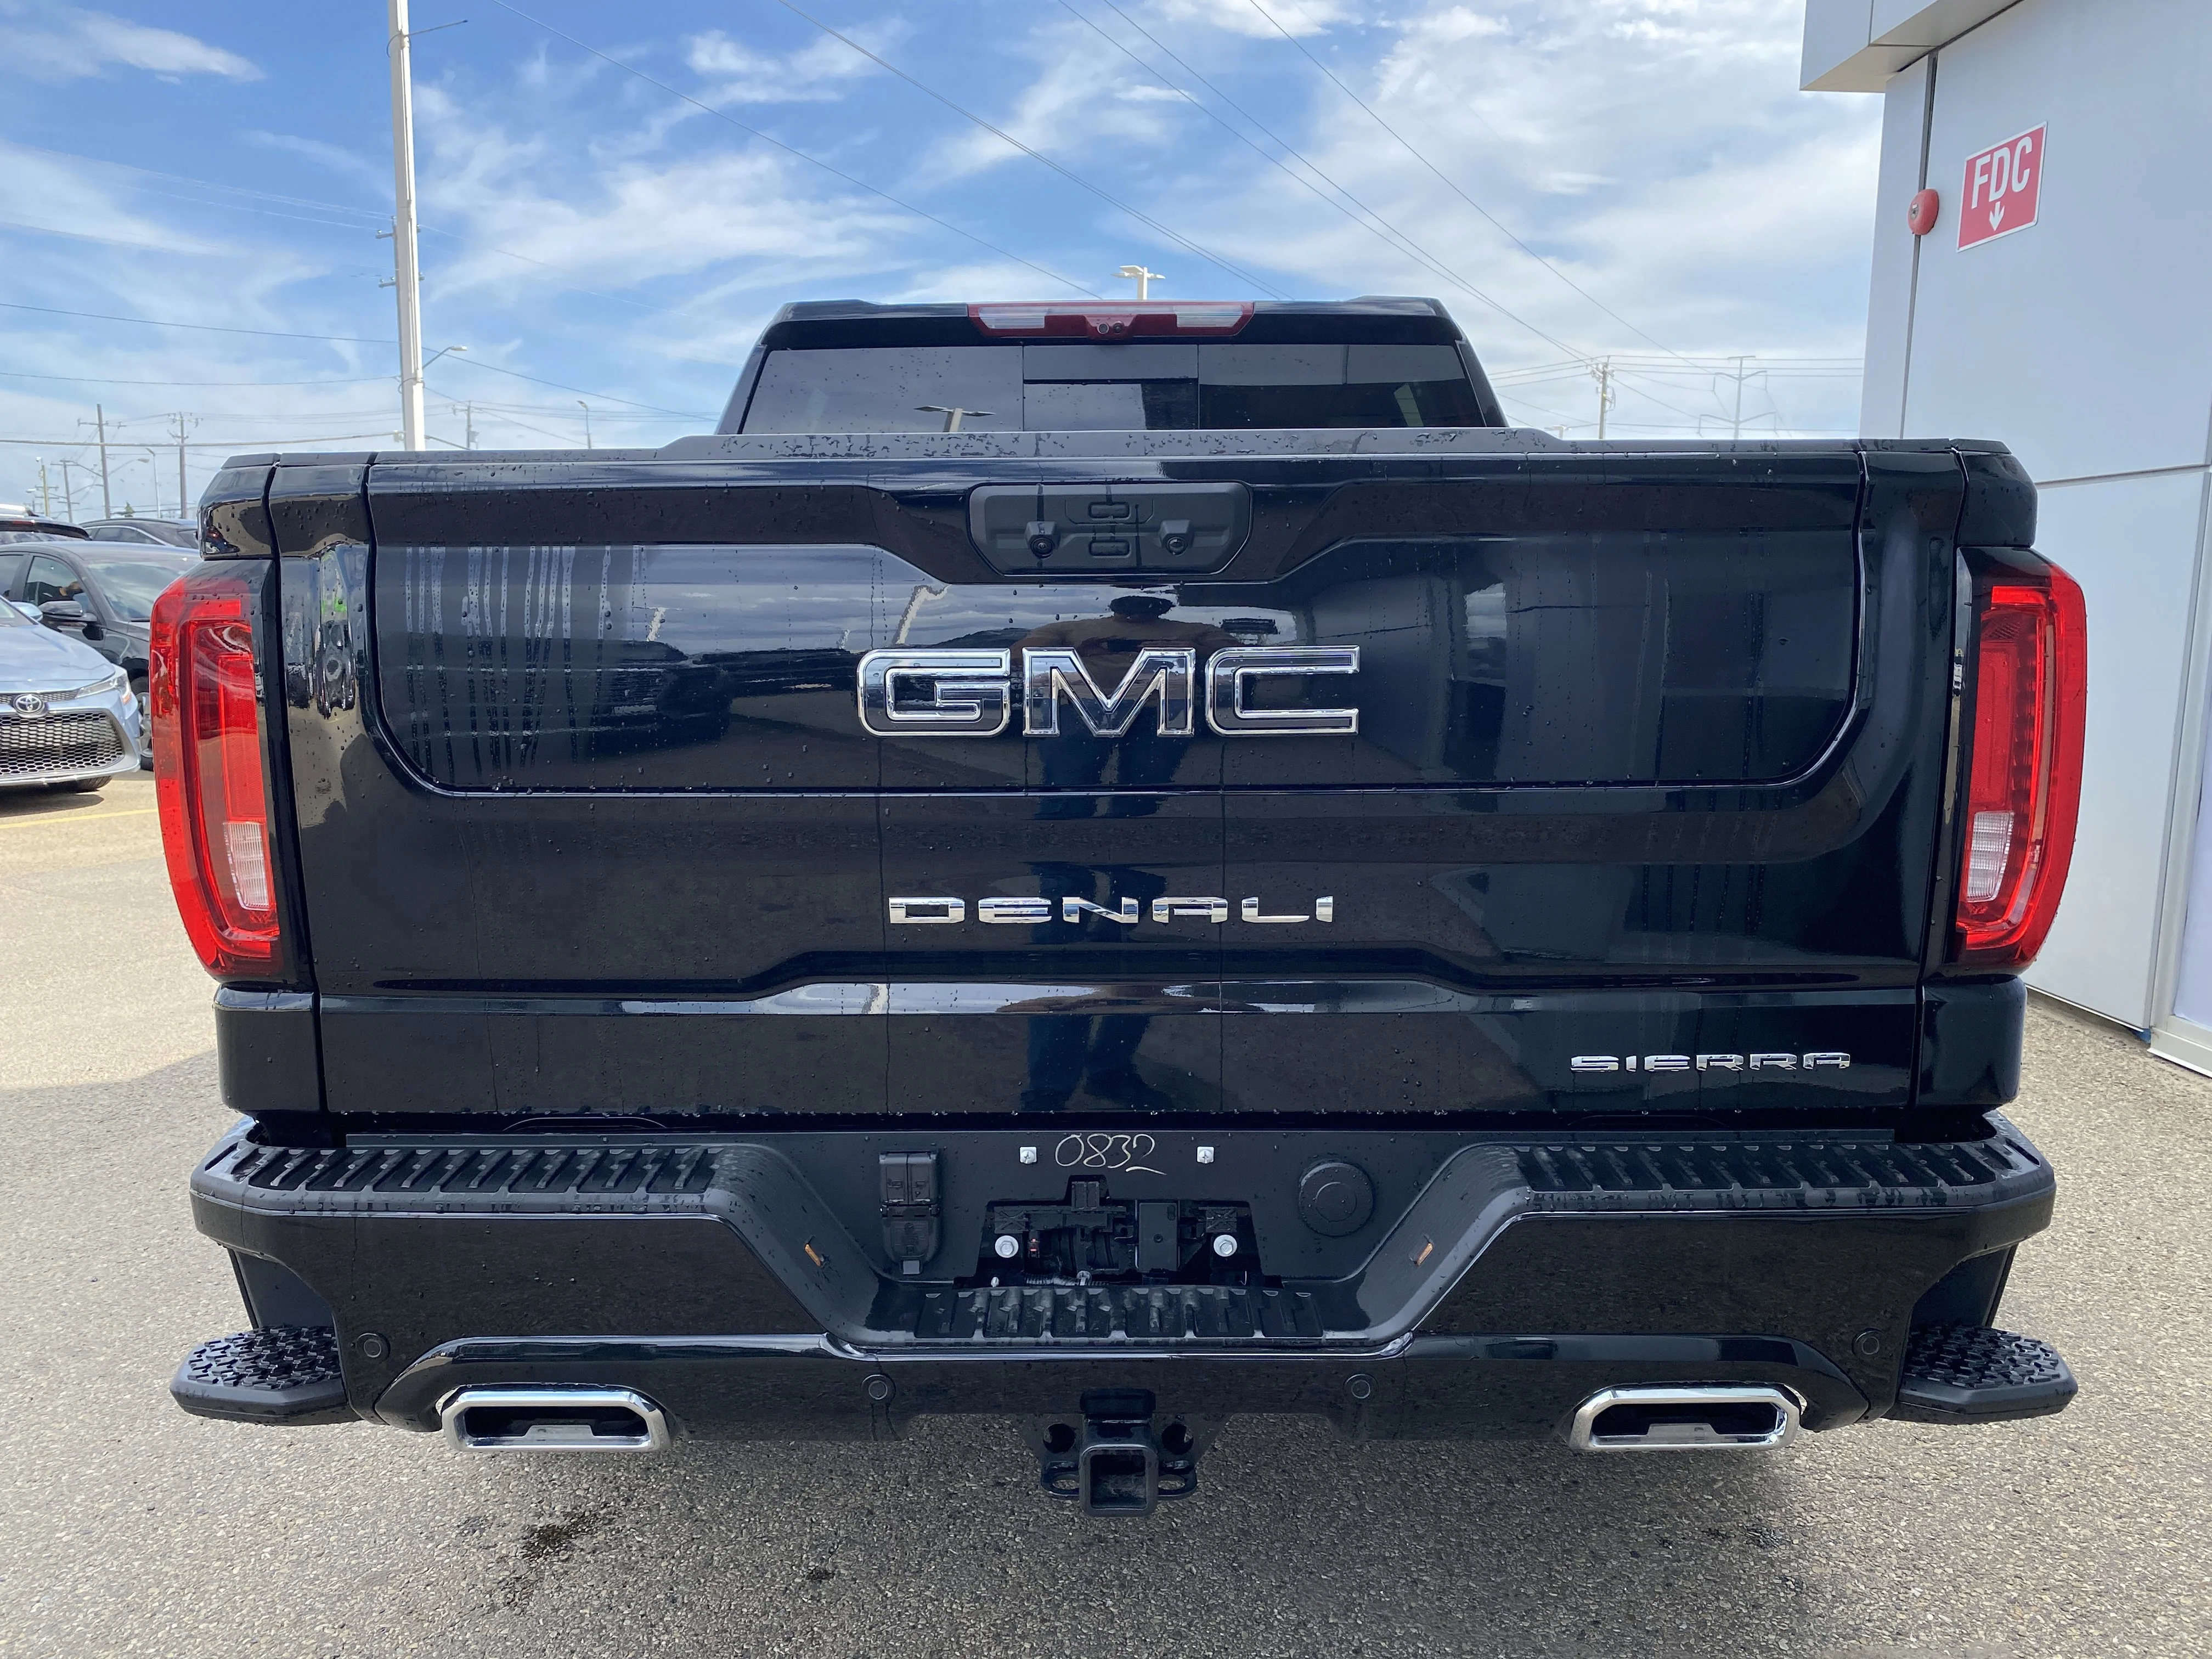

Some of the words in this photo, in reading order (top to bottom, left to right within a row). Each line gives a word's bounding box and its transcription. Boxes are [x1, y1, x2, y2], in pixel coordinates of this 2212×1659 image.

[1971, 136, 2033, 209] FDC
[857, 645, 1361, 738] GMC
[888, 896, 1334, 924] DENALI
[1570, 1052, 1851, 1073] SIERRA
[1055, 1133, 1167, 1175] 0832
